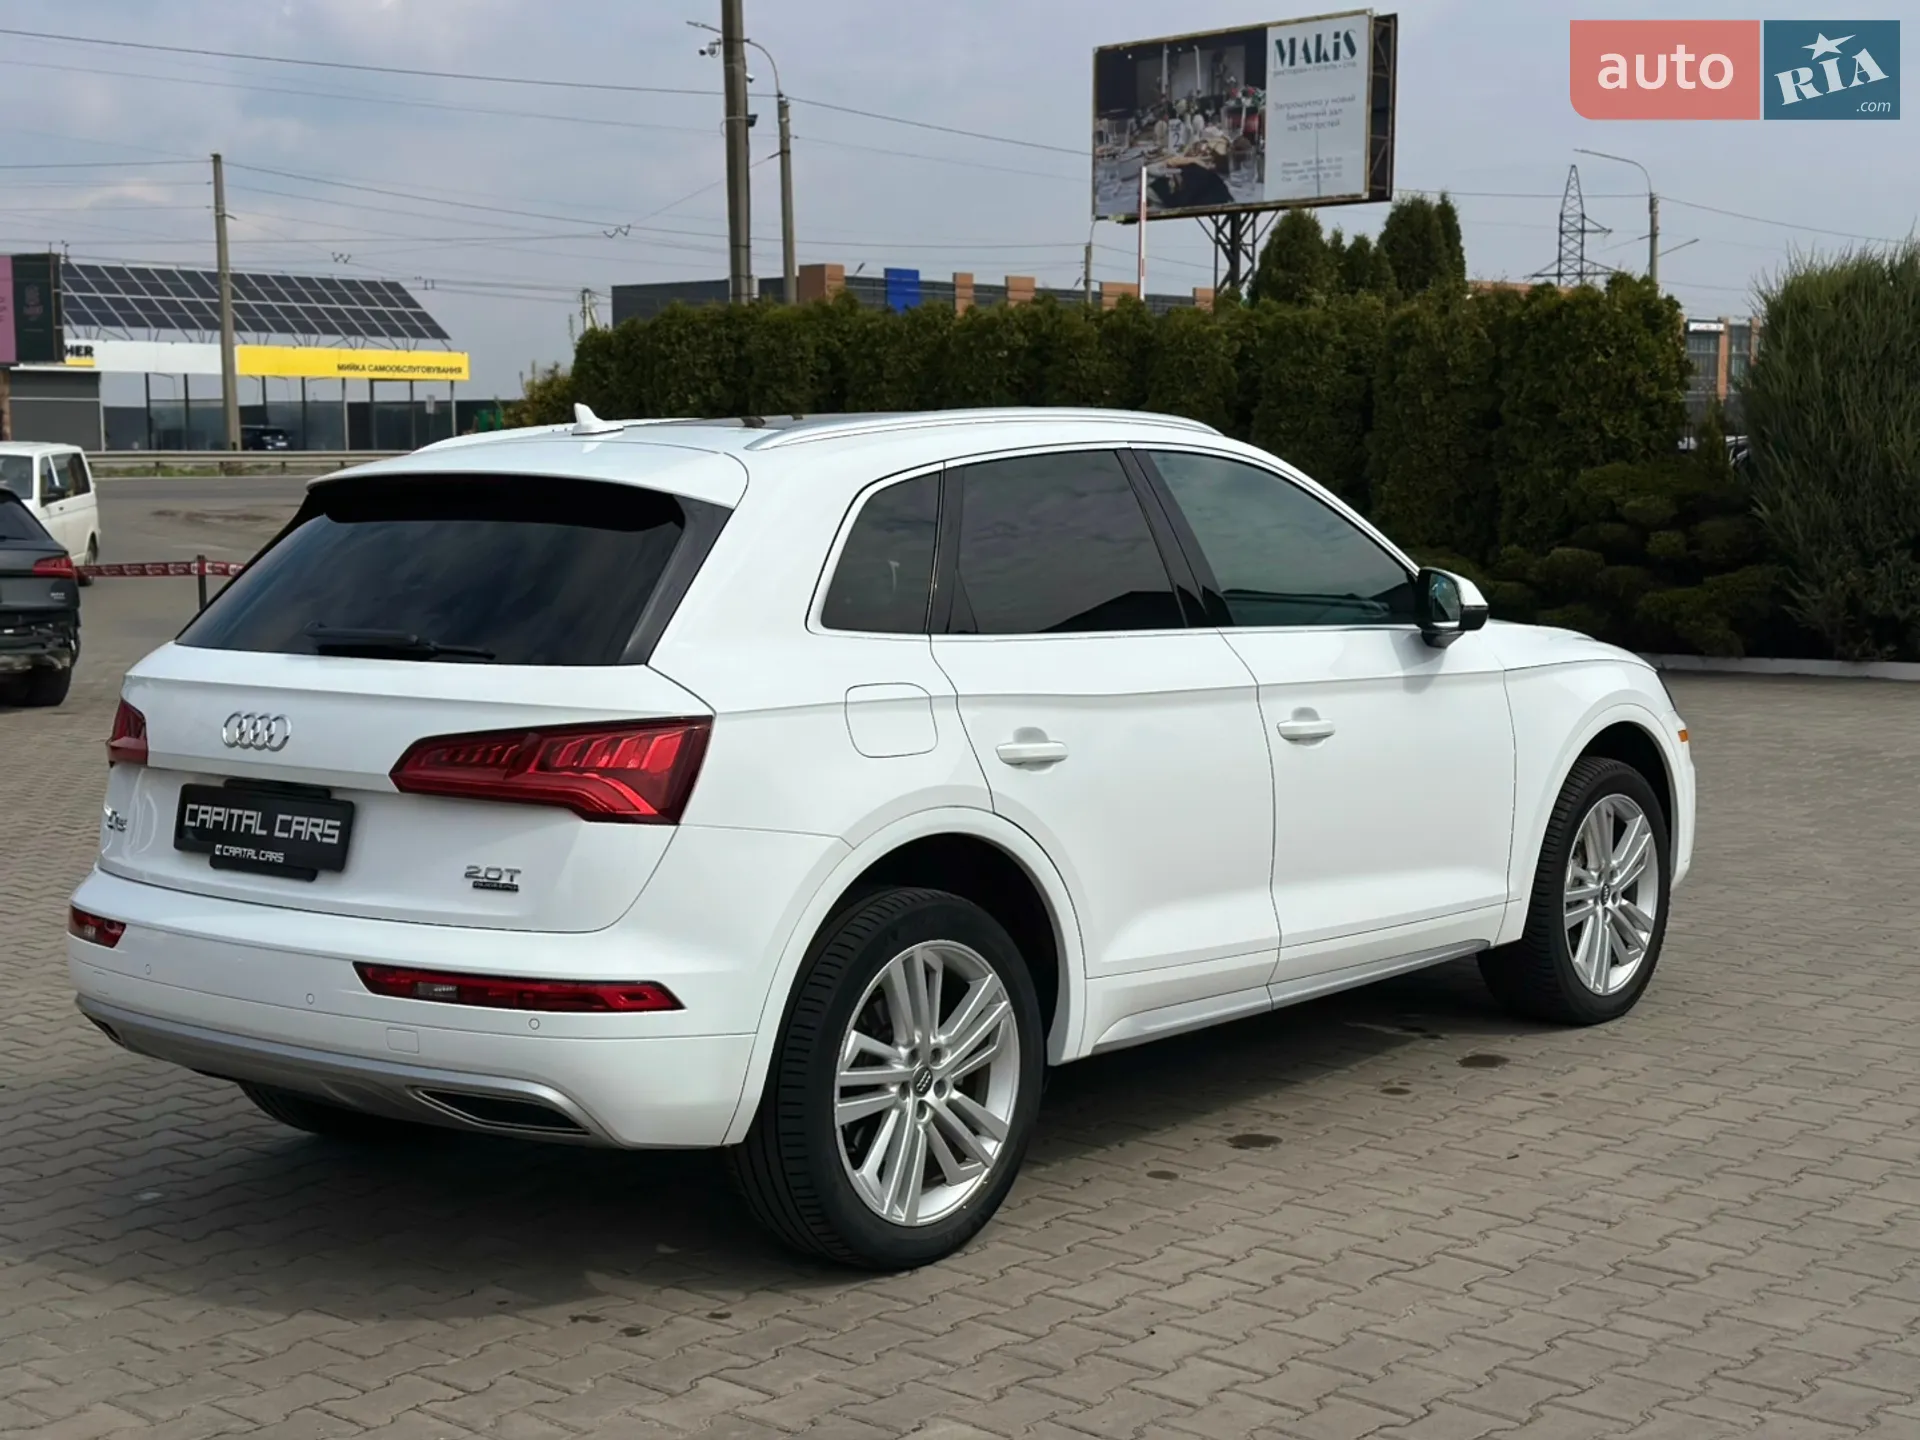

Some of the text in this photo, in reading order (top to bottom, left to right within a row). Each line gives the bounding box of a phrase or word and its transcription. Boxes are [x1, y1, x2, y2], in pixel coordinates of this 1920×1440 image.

[337, 362, 366, 372] МИЙКА
[183, 803, 342, 845] CAPITAL CARS
[222, 845, 285, 863] CAPITAL CARS
